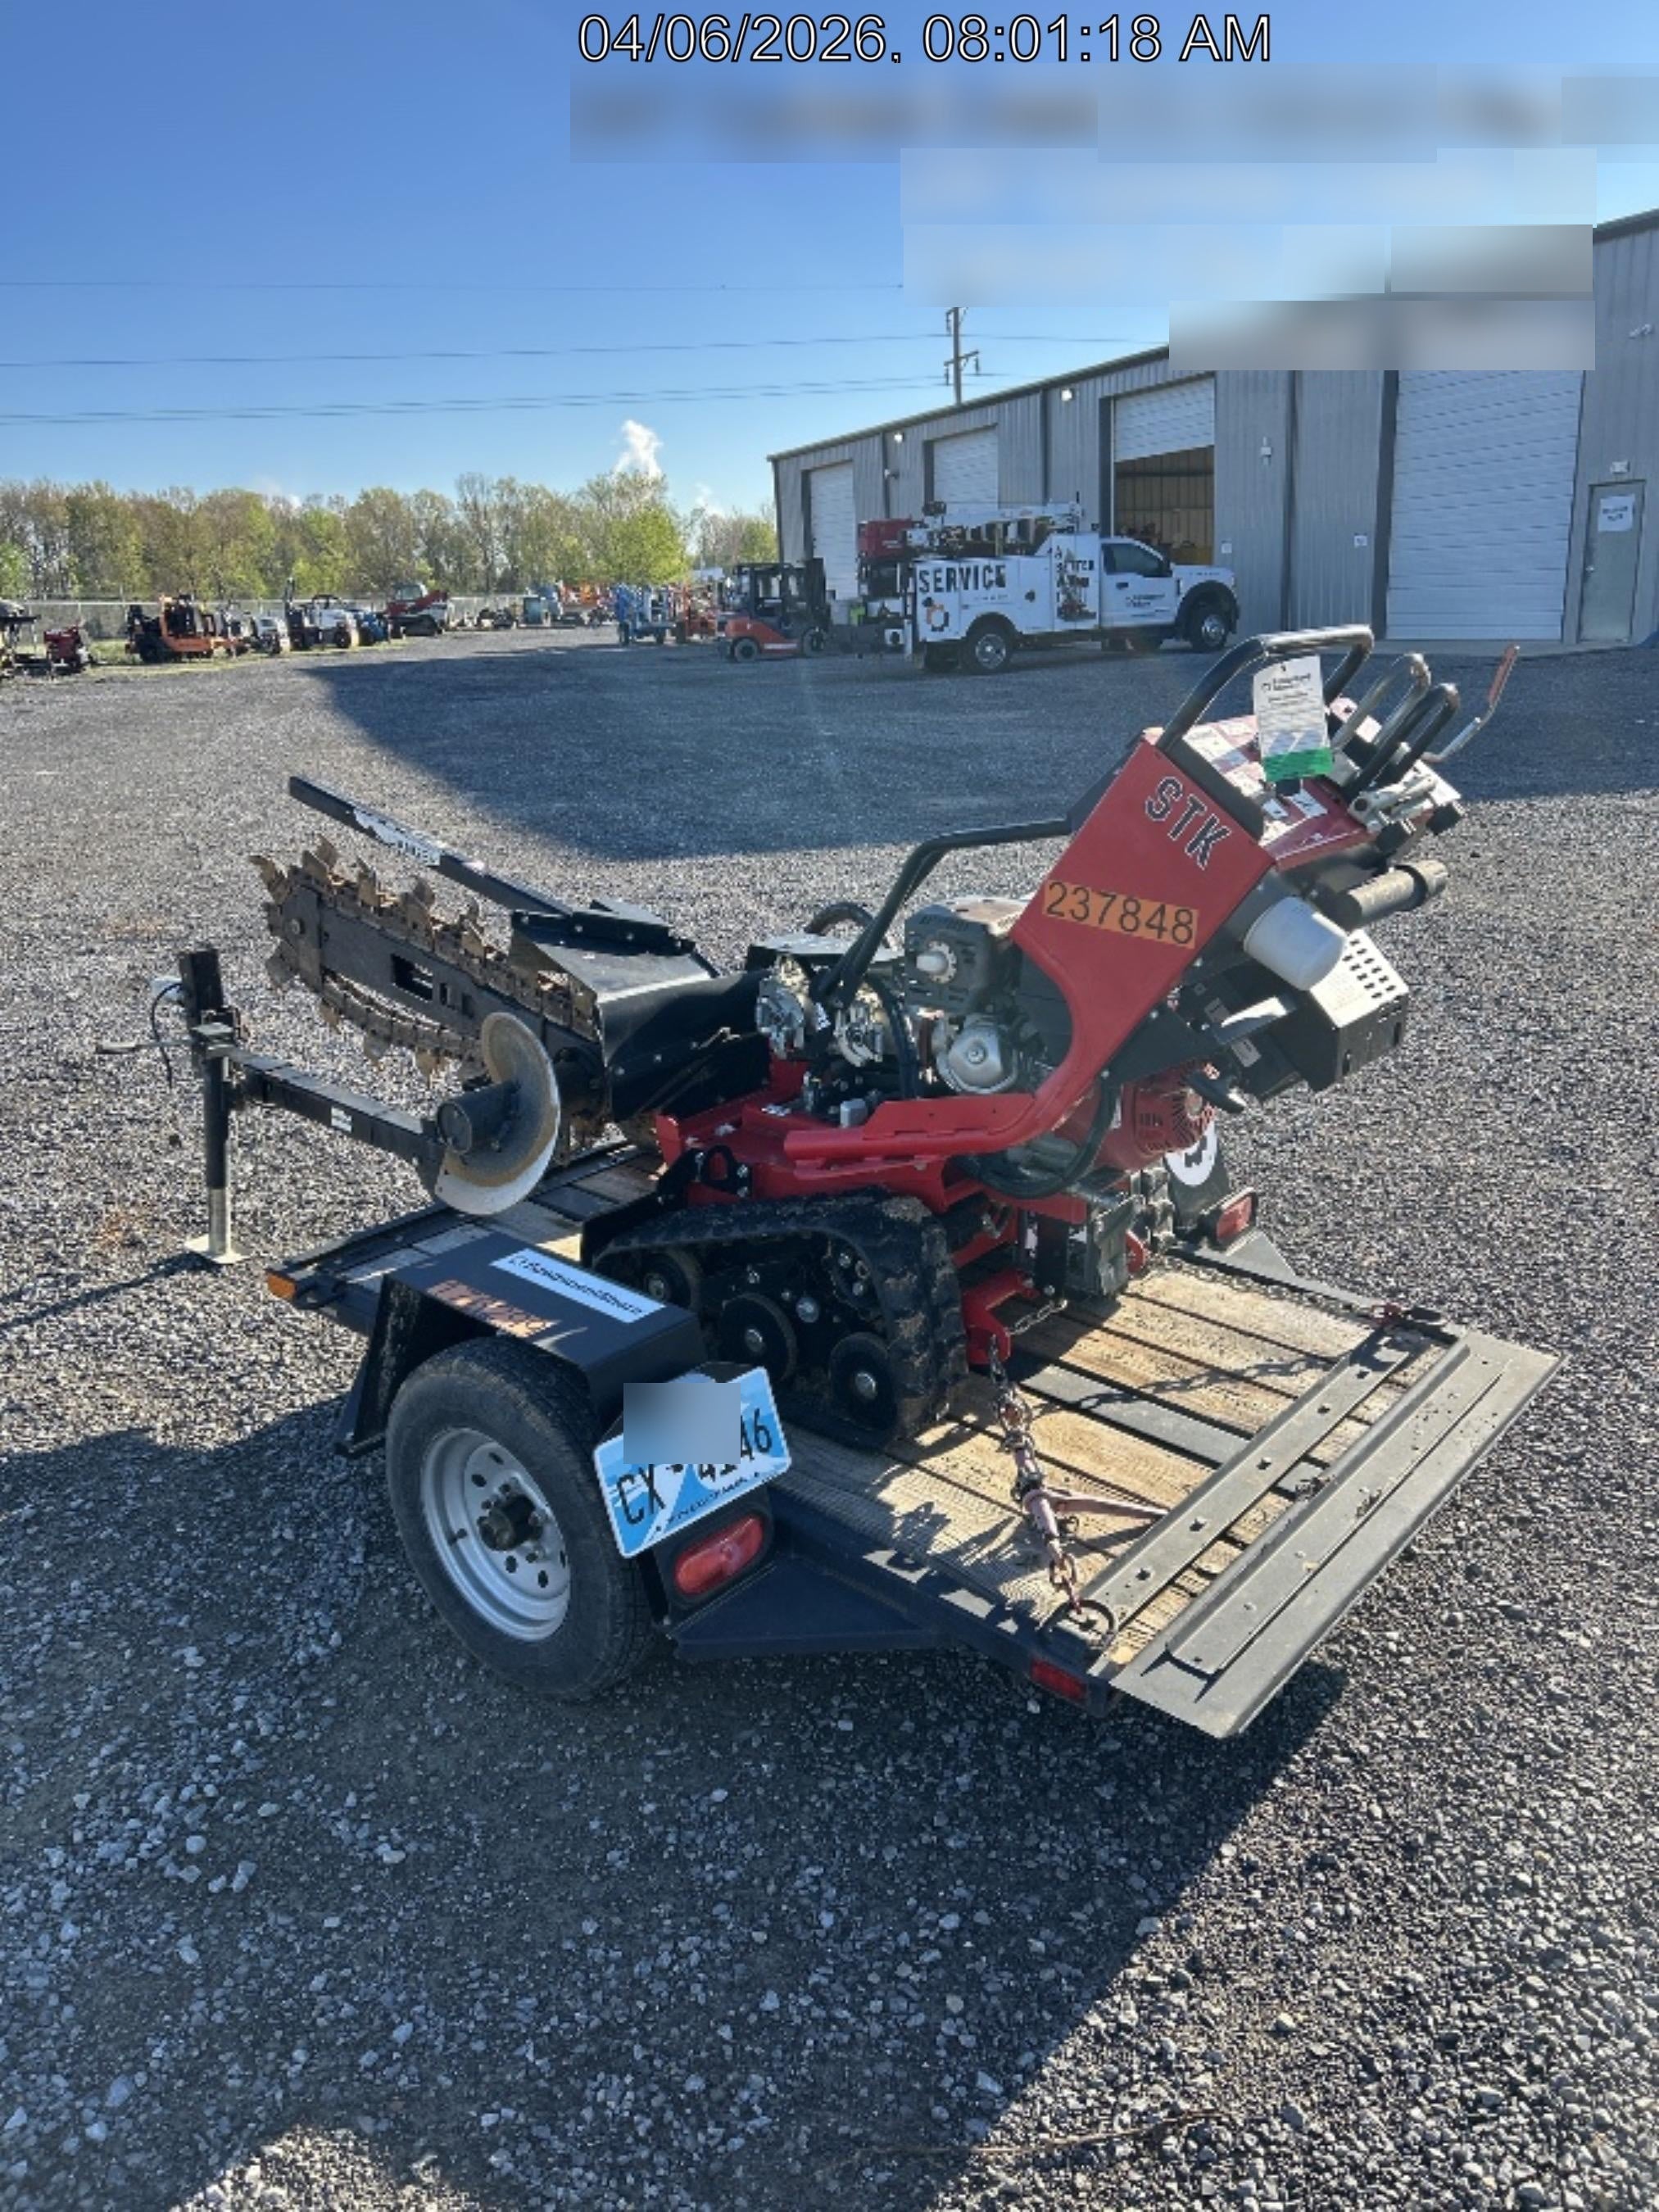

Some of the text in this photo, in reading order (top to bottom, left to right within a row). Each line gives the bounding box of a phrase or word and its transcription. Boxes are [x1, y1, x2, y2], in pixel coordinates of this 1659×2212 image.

[918, 564, 1006, 593] SERVICE
[1145, 776, 1231, 870] STK
[1045, 881, 1194, 945] 237848
